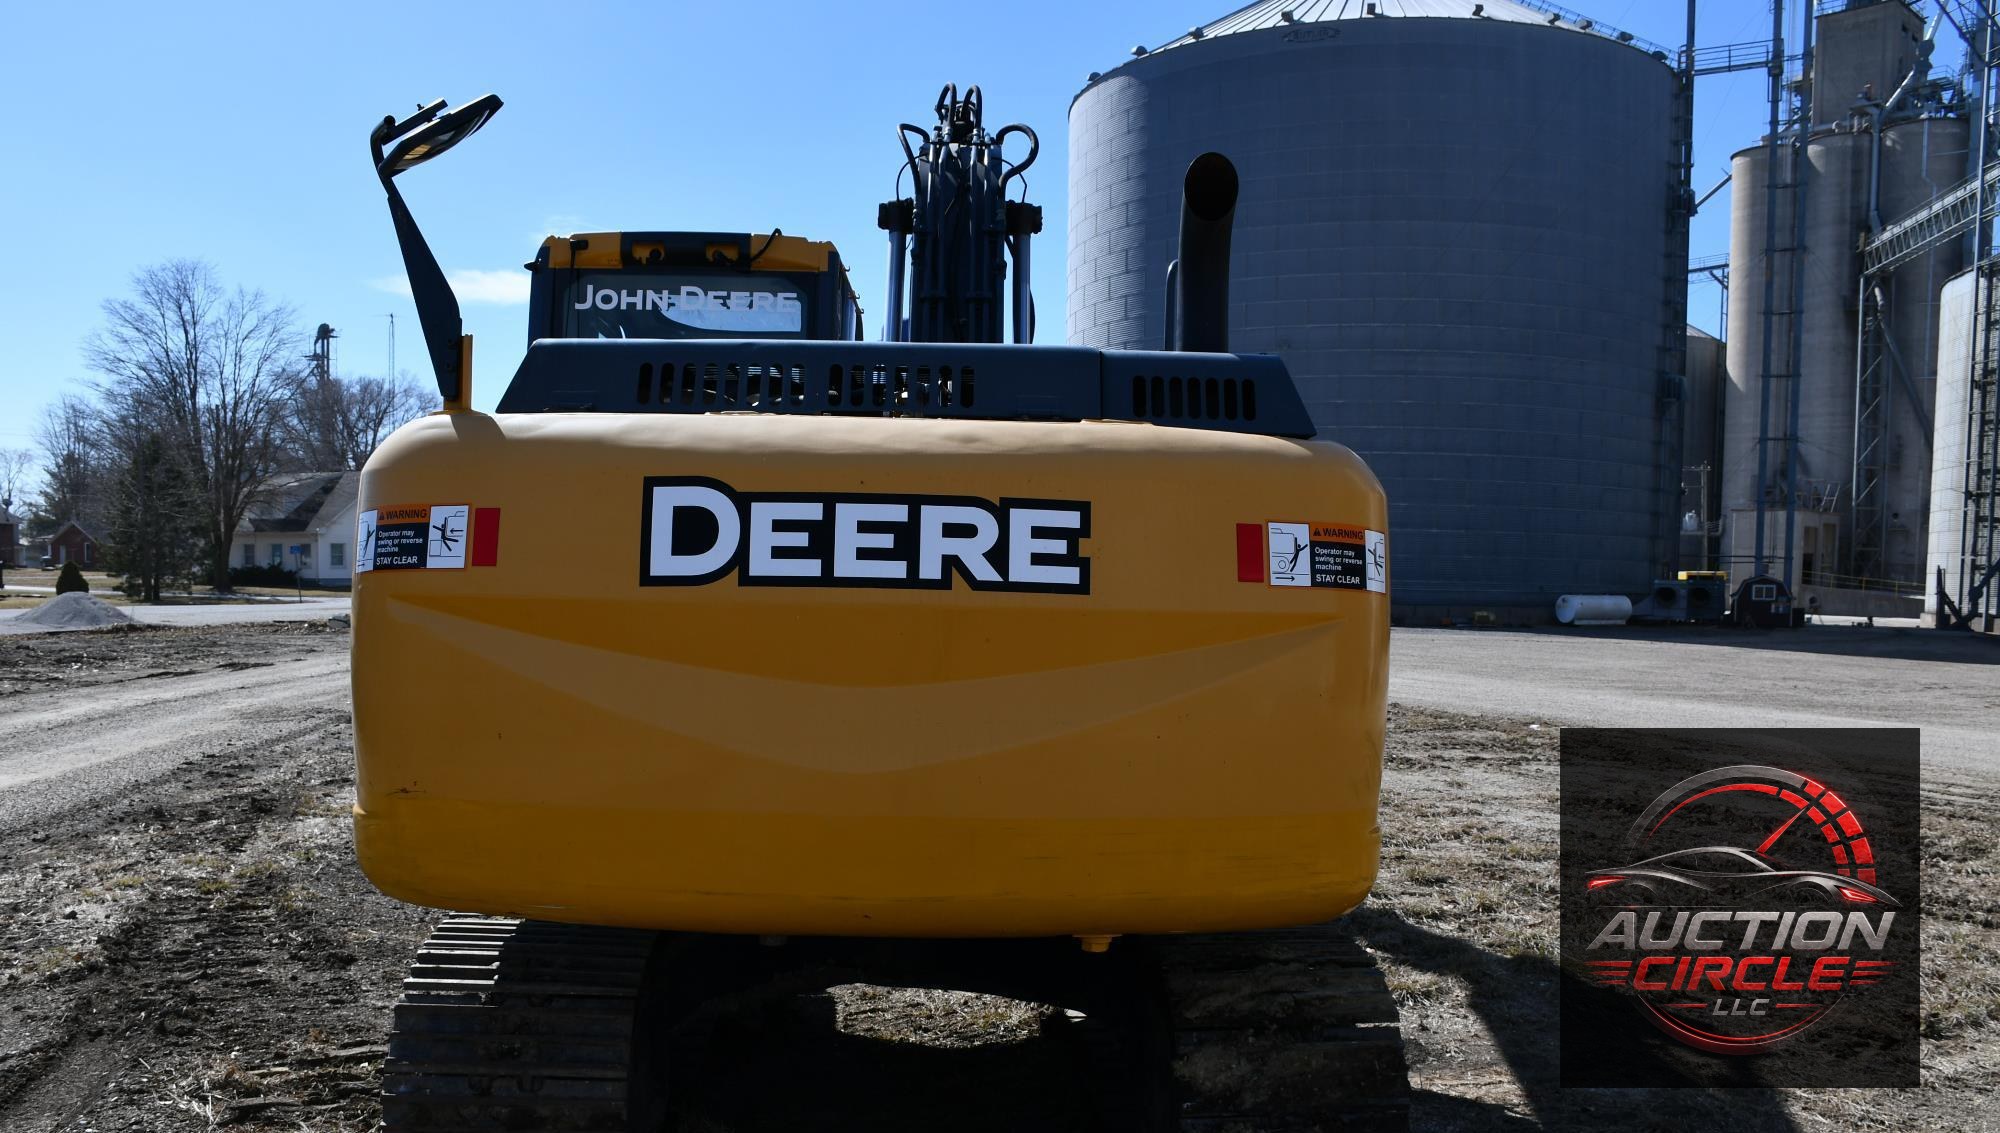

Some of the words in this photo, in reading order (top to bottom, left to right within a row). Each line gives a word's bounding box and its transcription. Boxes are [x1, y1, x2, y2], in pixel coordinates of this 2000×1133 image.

[574, 284, 668, 311] JOHN
[680, 285, 799, 313] DEERE
[386, 508, 427, 520] WARNING
[378, 530, 401, 538] Operator
[649, 485, 1081, 585] DEERE
[1323, 528, 1364, 540] WARNING
[1315, 547, 1342, 557] Operator
[1343, 550, 1355, 558] may
[376, 557, 392, 566] STAY
[393, 555, 418, 565] CLEAR
[1315, 556, 1334, 564] swing
[1343, 557, 1363, 565] reverse
[1315, 563, 1342, 571] machine
[1316, 574, 1335, 583] STAY
[1337, 575, 1361, 585] CLEAR
